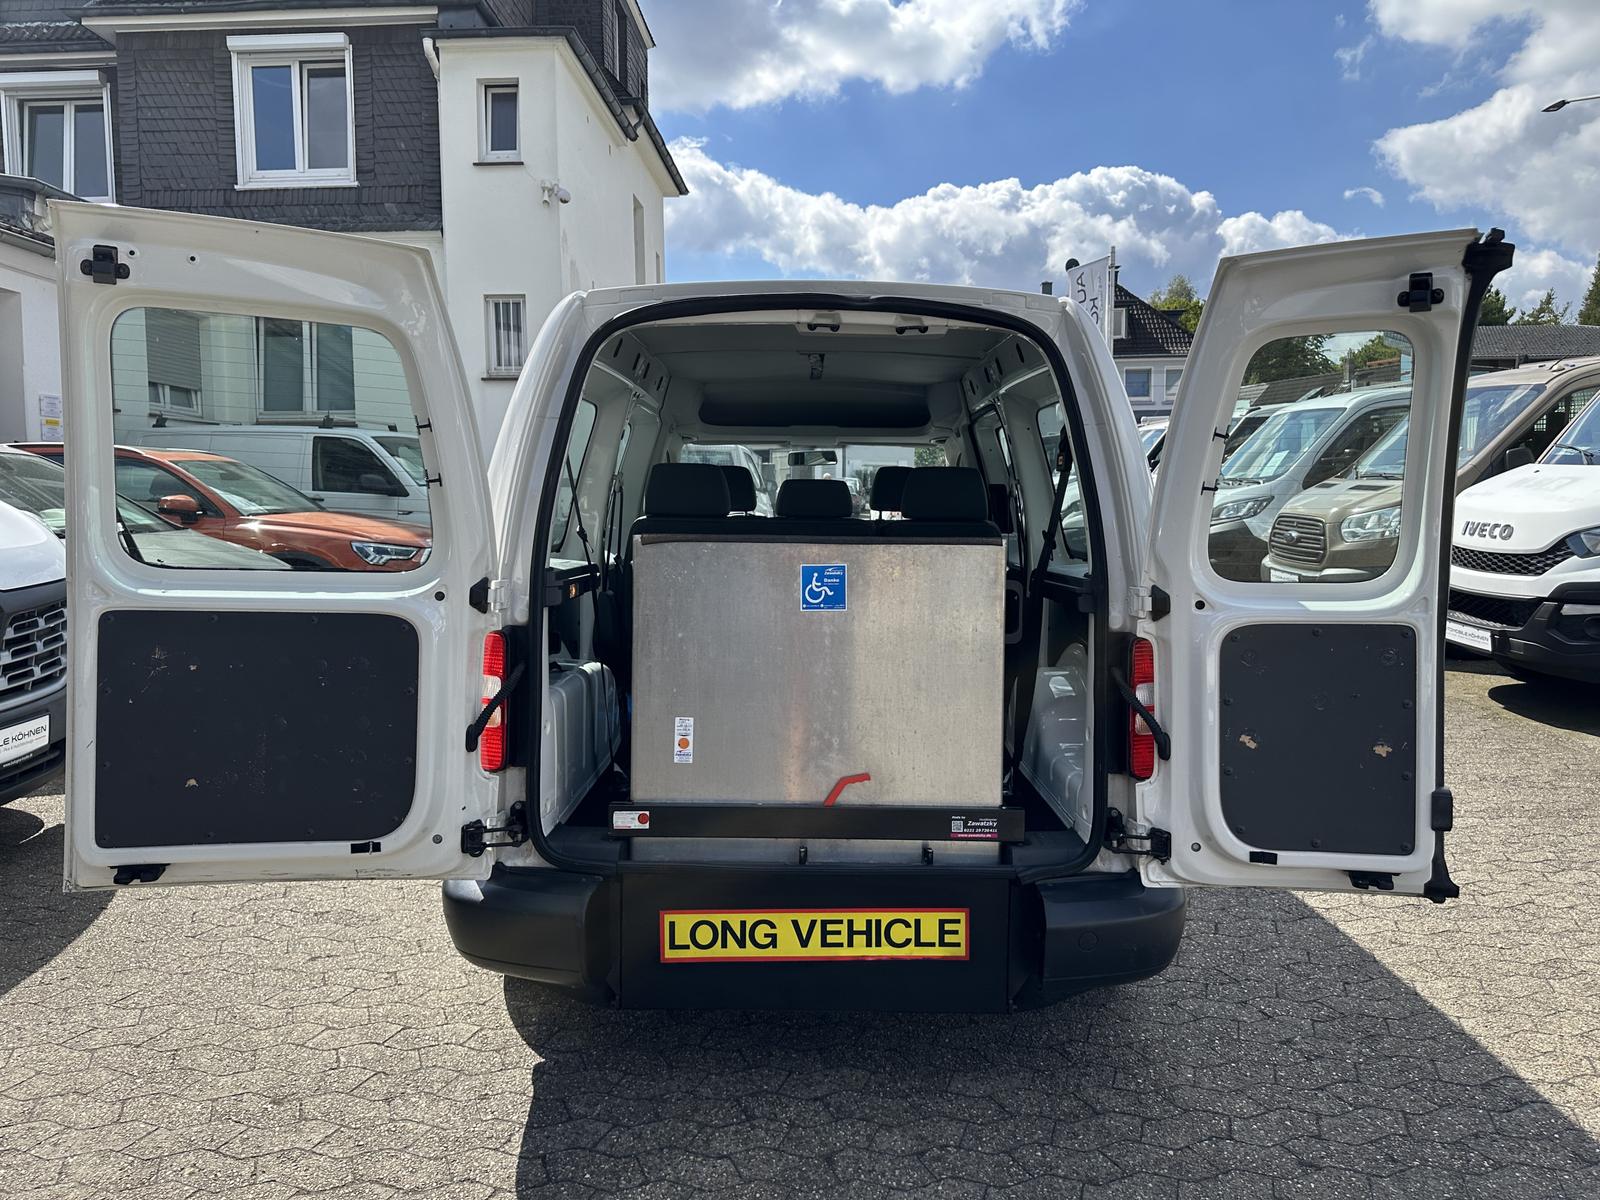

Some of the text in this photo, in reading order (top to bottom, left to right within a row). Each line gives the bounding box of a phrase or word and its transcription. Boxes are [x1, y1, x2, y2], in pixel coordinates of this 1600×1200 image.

[1461, 520, 1514, 541] IVECO
[11, 725, 47, 743] KÖHNEN
[668, 918, 961, 950] LONG VEHICLE
